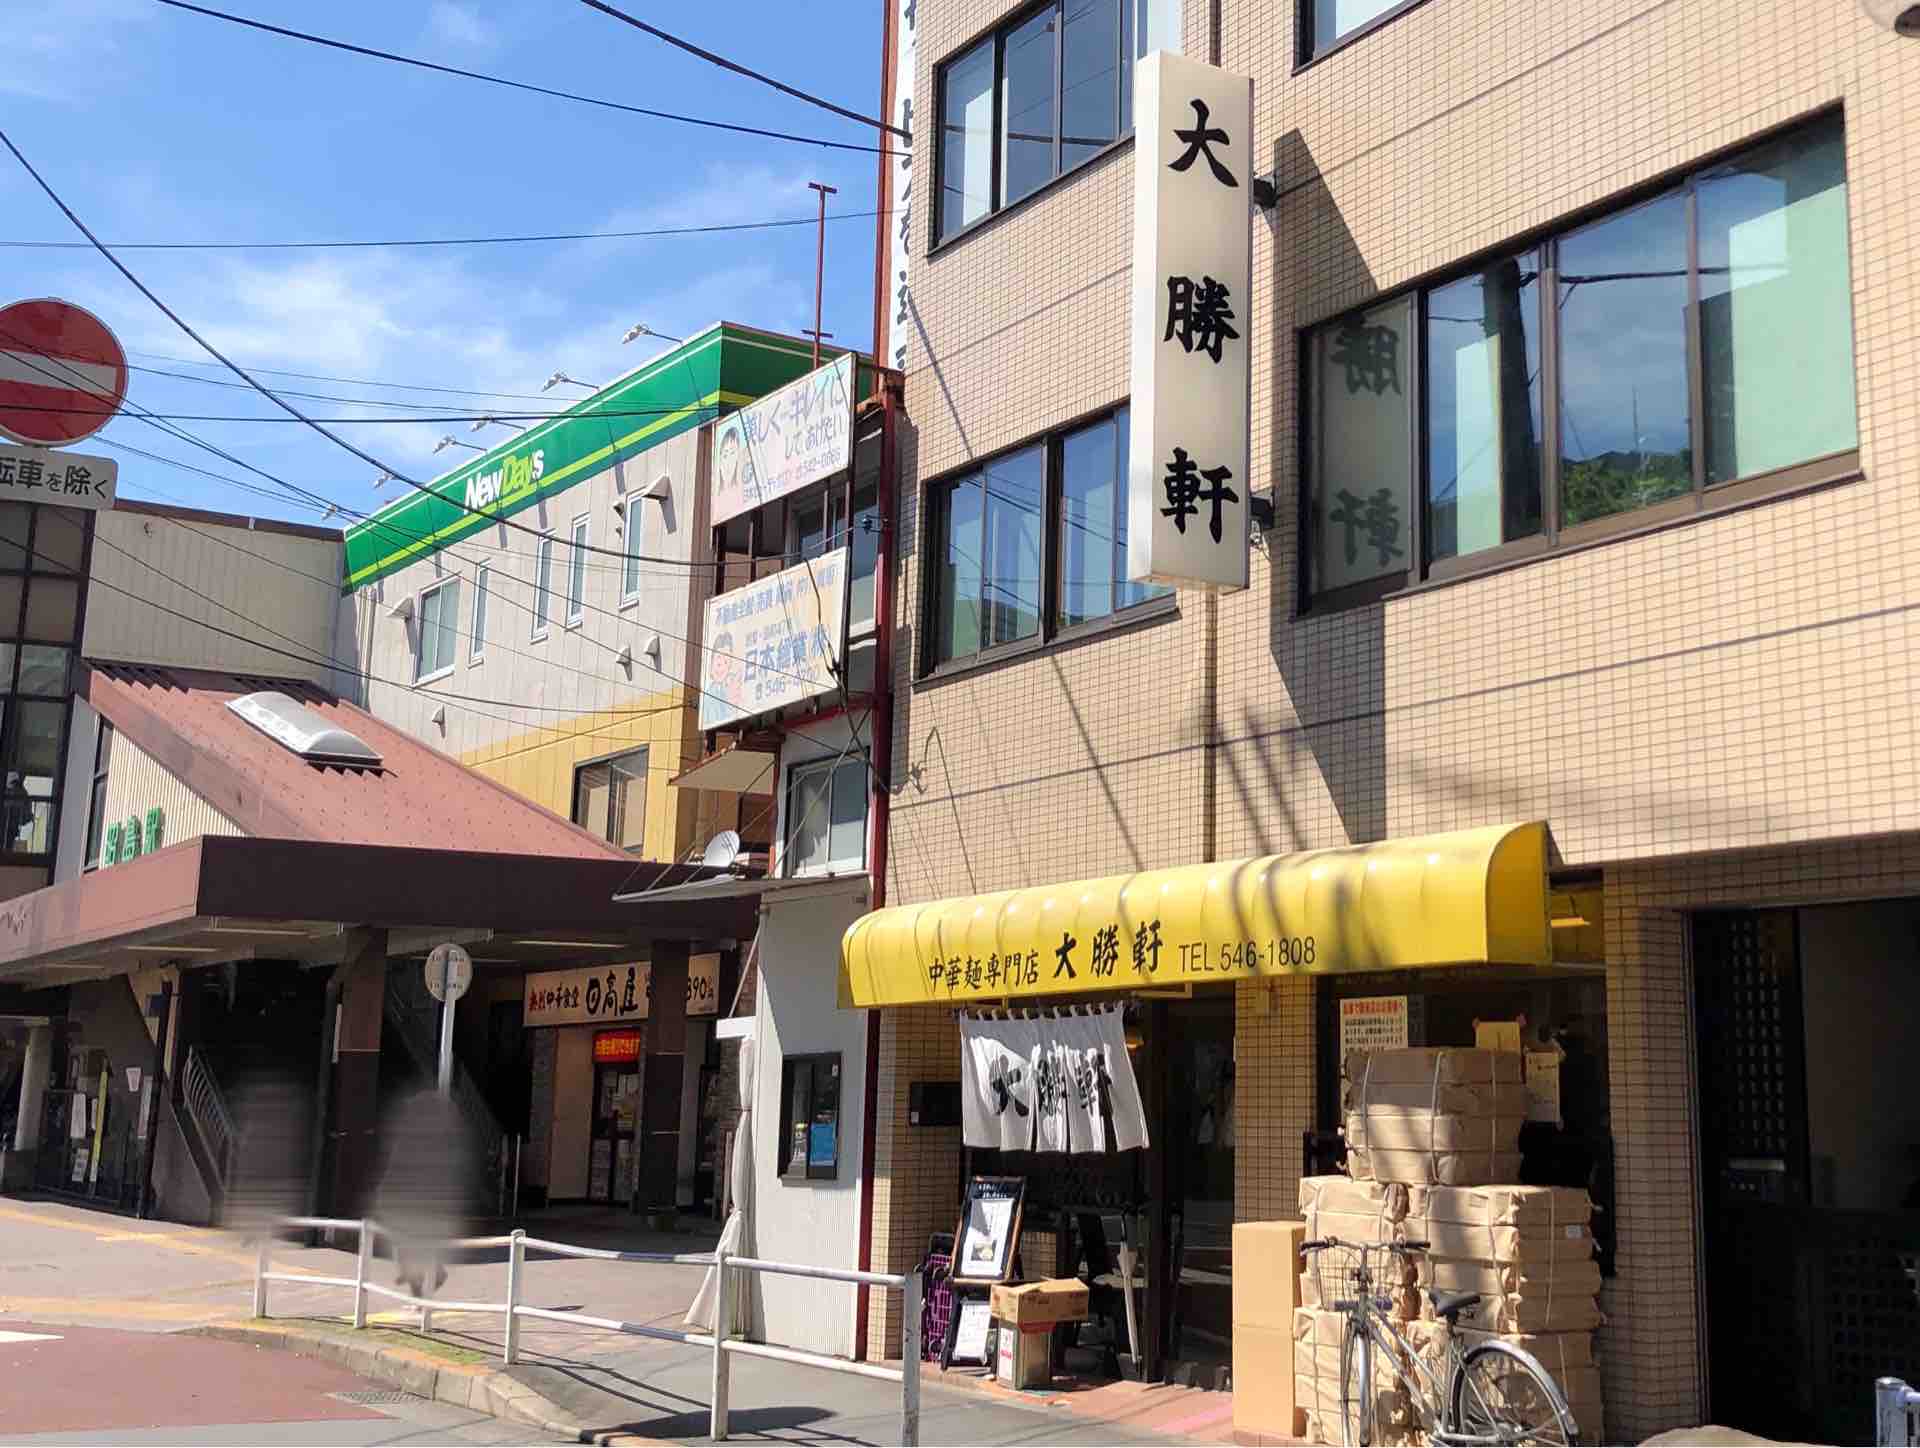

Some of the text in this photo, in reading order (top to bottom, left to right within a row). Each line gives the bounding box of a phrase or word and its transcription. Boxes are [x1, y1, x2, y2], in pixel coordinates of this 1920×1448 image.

[1160, 98, 1240, 545] 大勝軒
[464, 449, 544, 515] NewDays
[1053, 919, 1163, 980] 大勝軒
[1178, 941, 1214, 973] TEL
[1220, 936, 1316, 972] 546-1808
